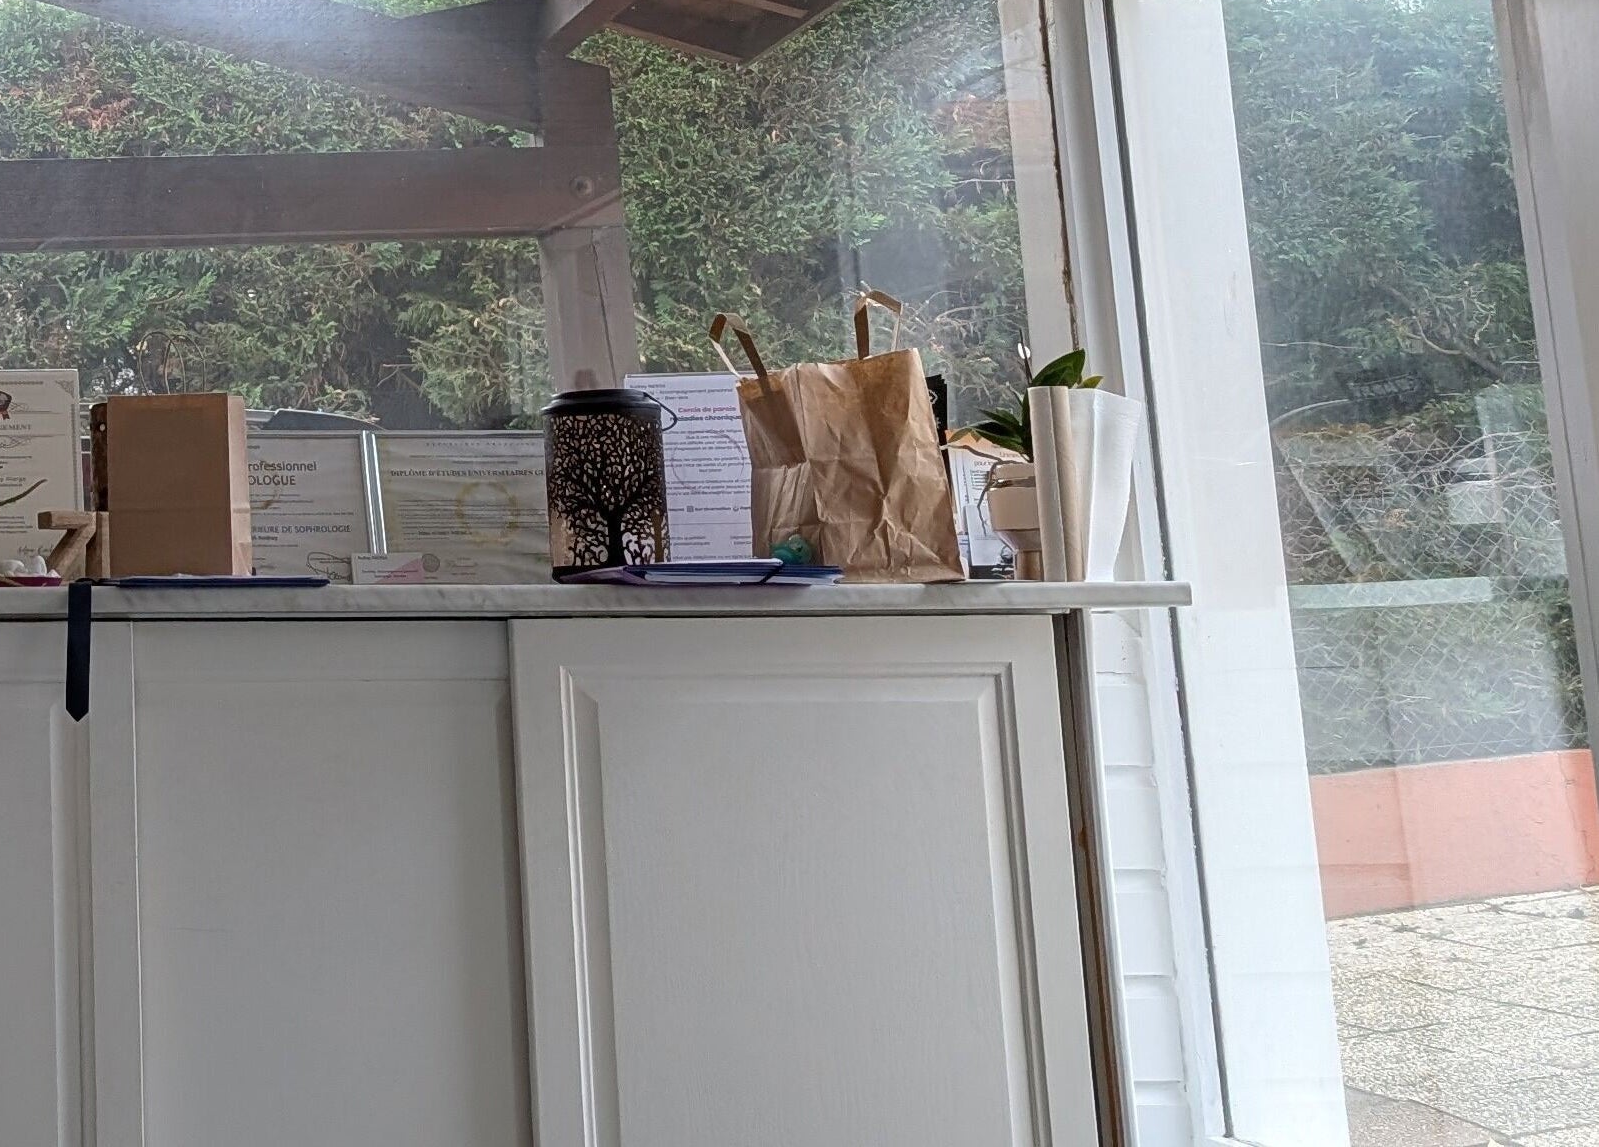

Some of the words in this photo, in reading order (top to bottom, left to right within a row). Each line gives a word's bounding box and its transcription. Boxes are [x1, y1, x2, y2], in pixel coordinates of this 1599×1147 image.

[248, 461, 317, 472] rofessionnel
[248, 475, 296, 486] OLOGUE
[281, 525, 293, 533] DE
[295, 524, 352, 533] SOPHROLOGIE
